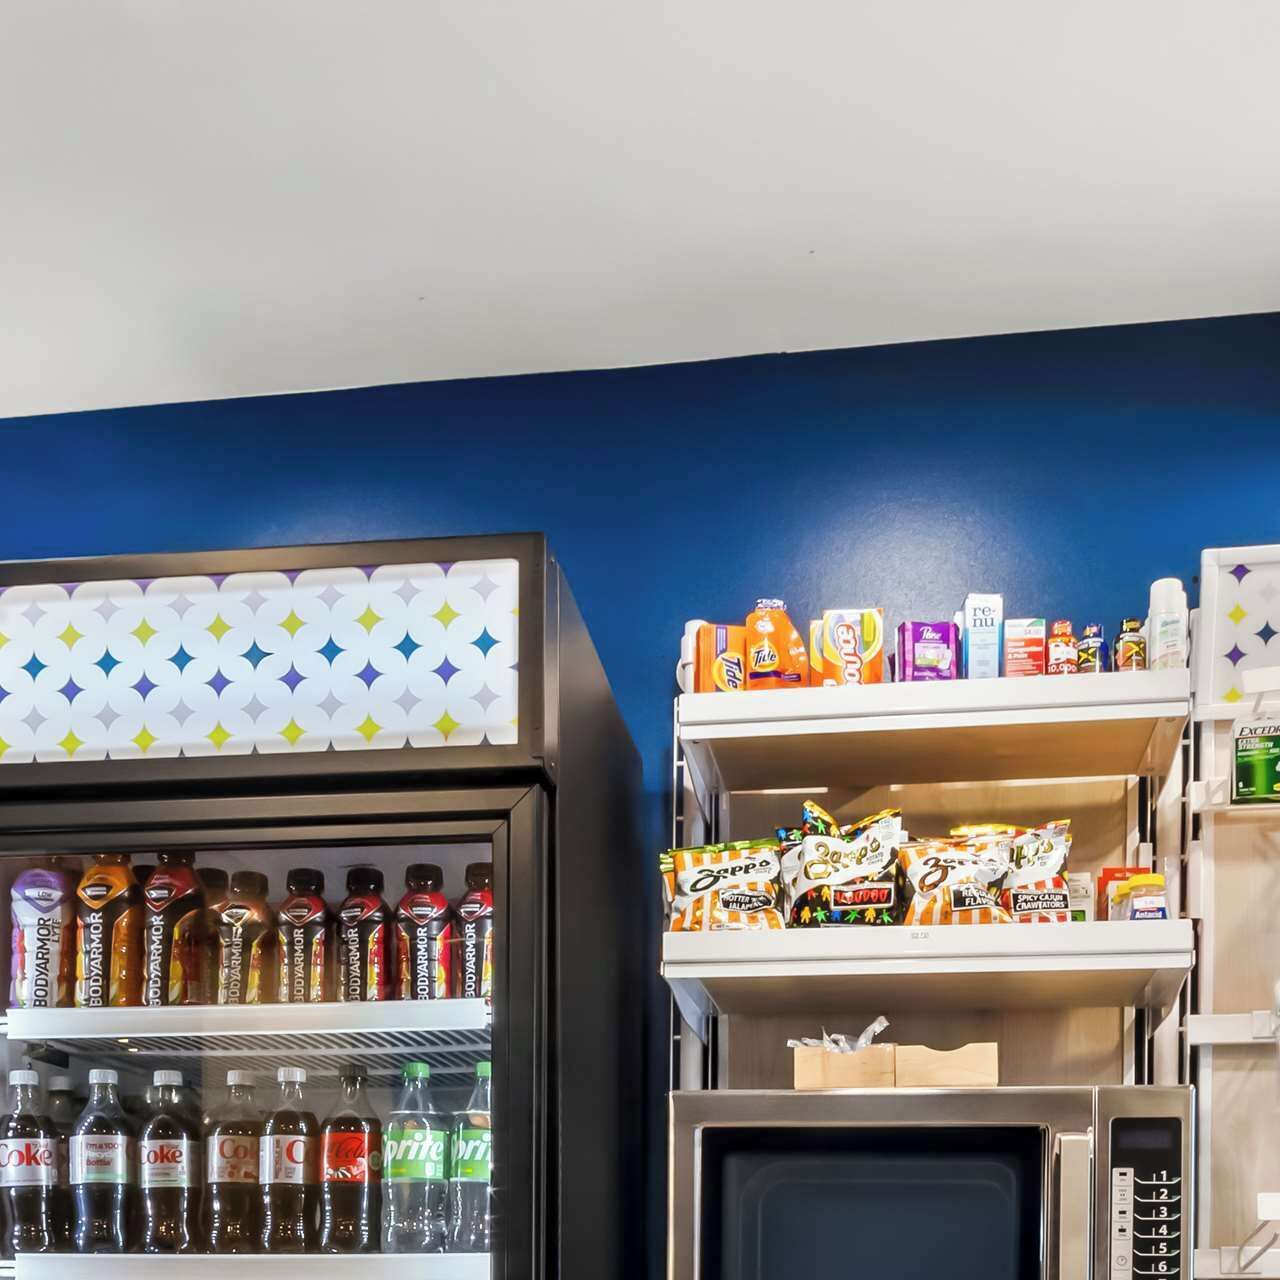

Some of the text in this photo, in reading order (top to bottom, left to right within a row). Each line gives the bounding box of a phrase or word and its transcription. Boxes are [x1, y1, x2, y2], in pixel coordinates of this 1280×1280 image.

[972, 605, 996, 616] re-
[972, 616, 995, 628] nu
[720, 655, 744, 691] Tide
[1017, 893, 1064, 903] SPICY CAJUN
[51, 918, 62, 944] LYTE
[33, 916, 52, 1008] BODYARMOR
[88, 911, 103, 1007] BODYARMOR
[149, 913, 164, 1008] BODYARMOR
[294, 927, 305, 1002] BODYARMOR
[348, 927, 359, 1002] BODYARMOR
[416, 927, 429, 1001] BODYARMOR
[1160, 1170, 1167, 1182] 1
[1159, 1188, 1168, 1200] 2
[1159, 1206, 1168, 1218] 3
[1159, 1224, 1168, 1235] 4
[1158, 1242, 1167, 1254] 5
[1158, 1261, 1167, 1272] 6
